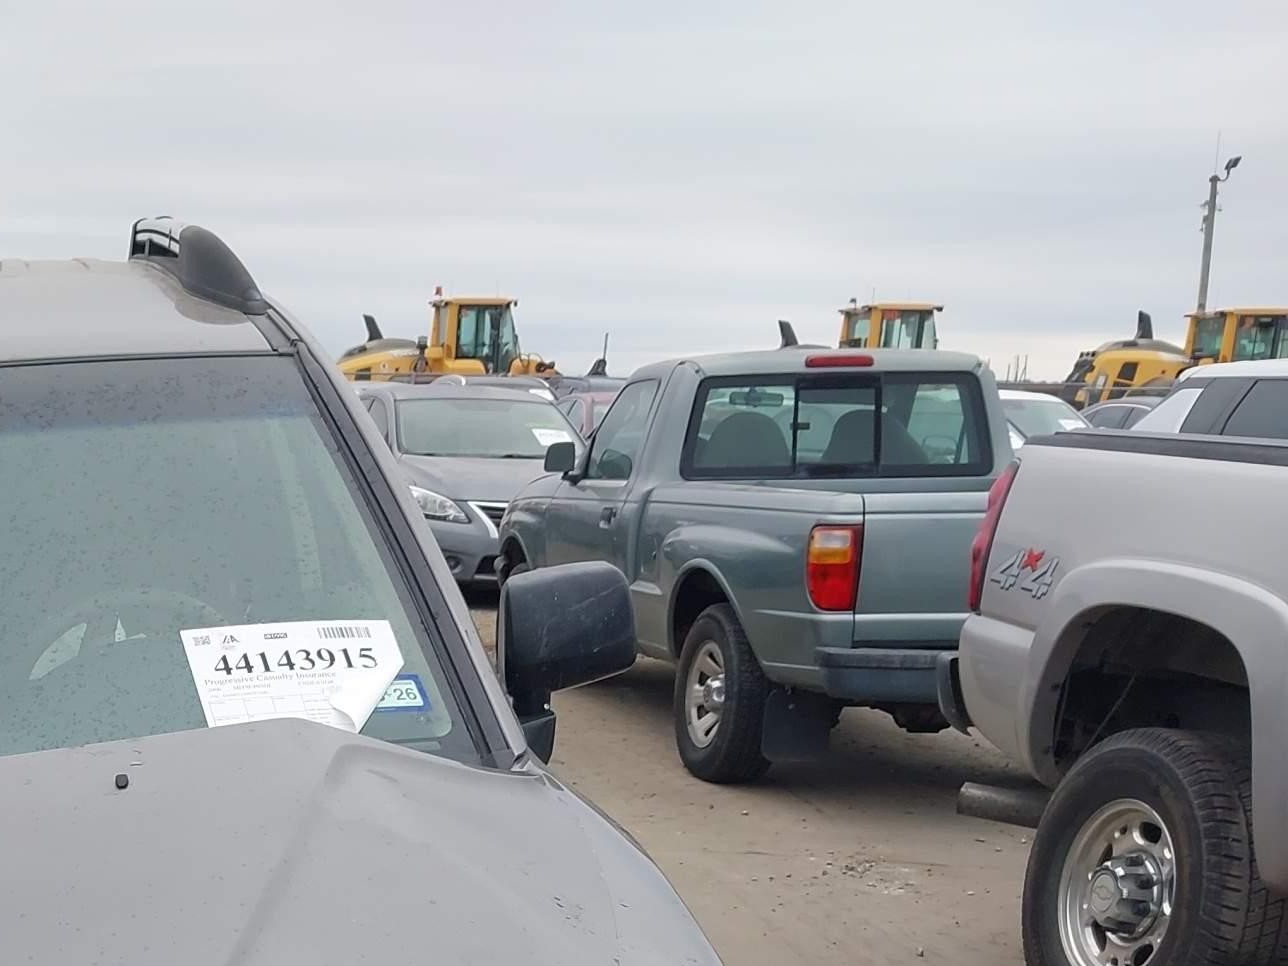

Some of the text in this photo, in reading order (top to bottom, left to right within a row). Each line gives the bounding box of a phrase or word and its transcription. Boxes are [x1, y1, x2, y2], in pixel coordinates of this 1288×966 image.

[214, 647, 378, 676] 44143915
[204, 671, 337, 687] Progressive Casualty Insurance
